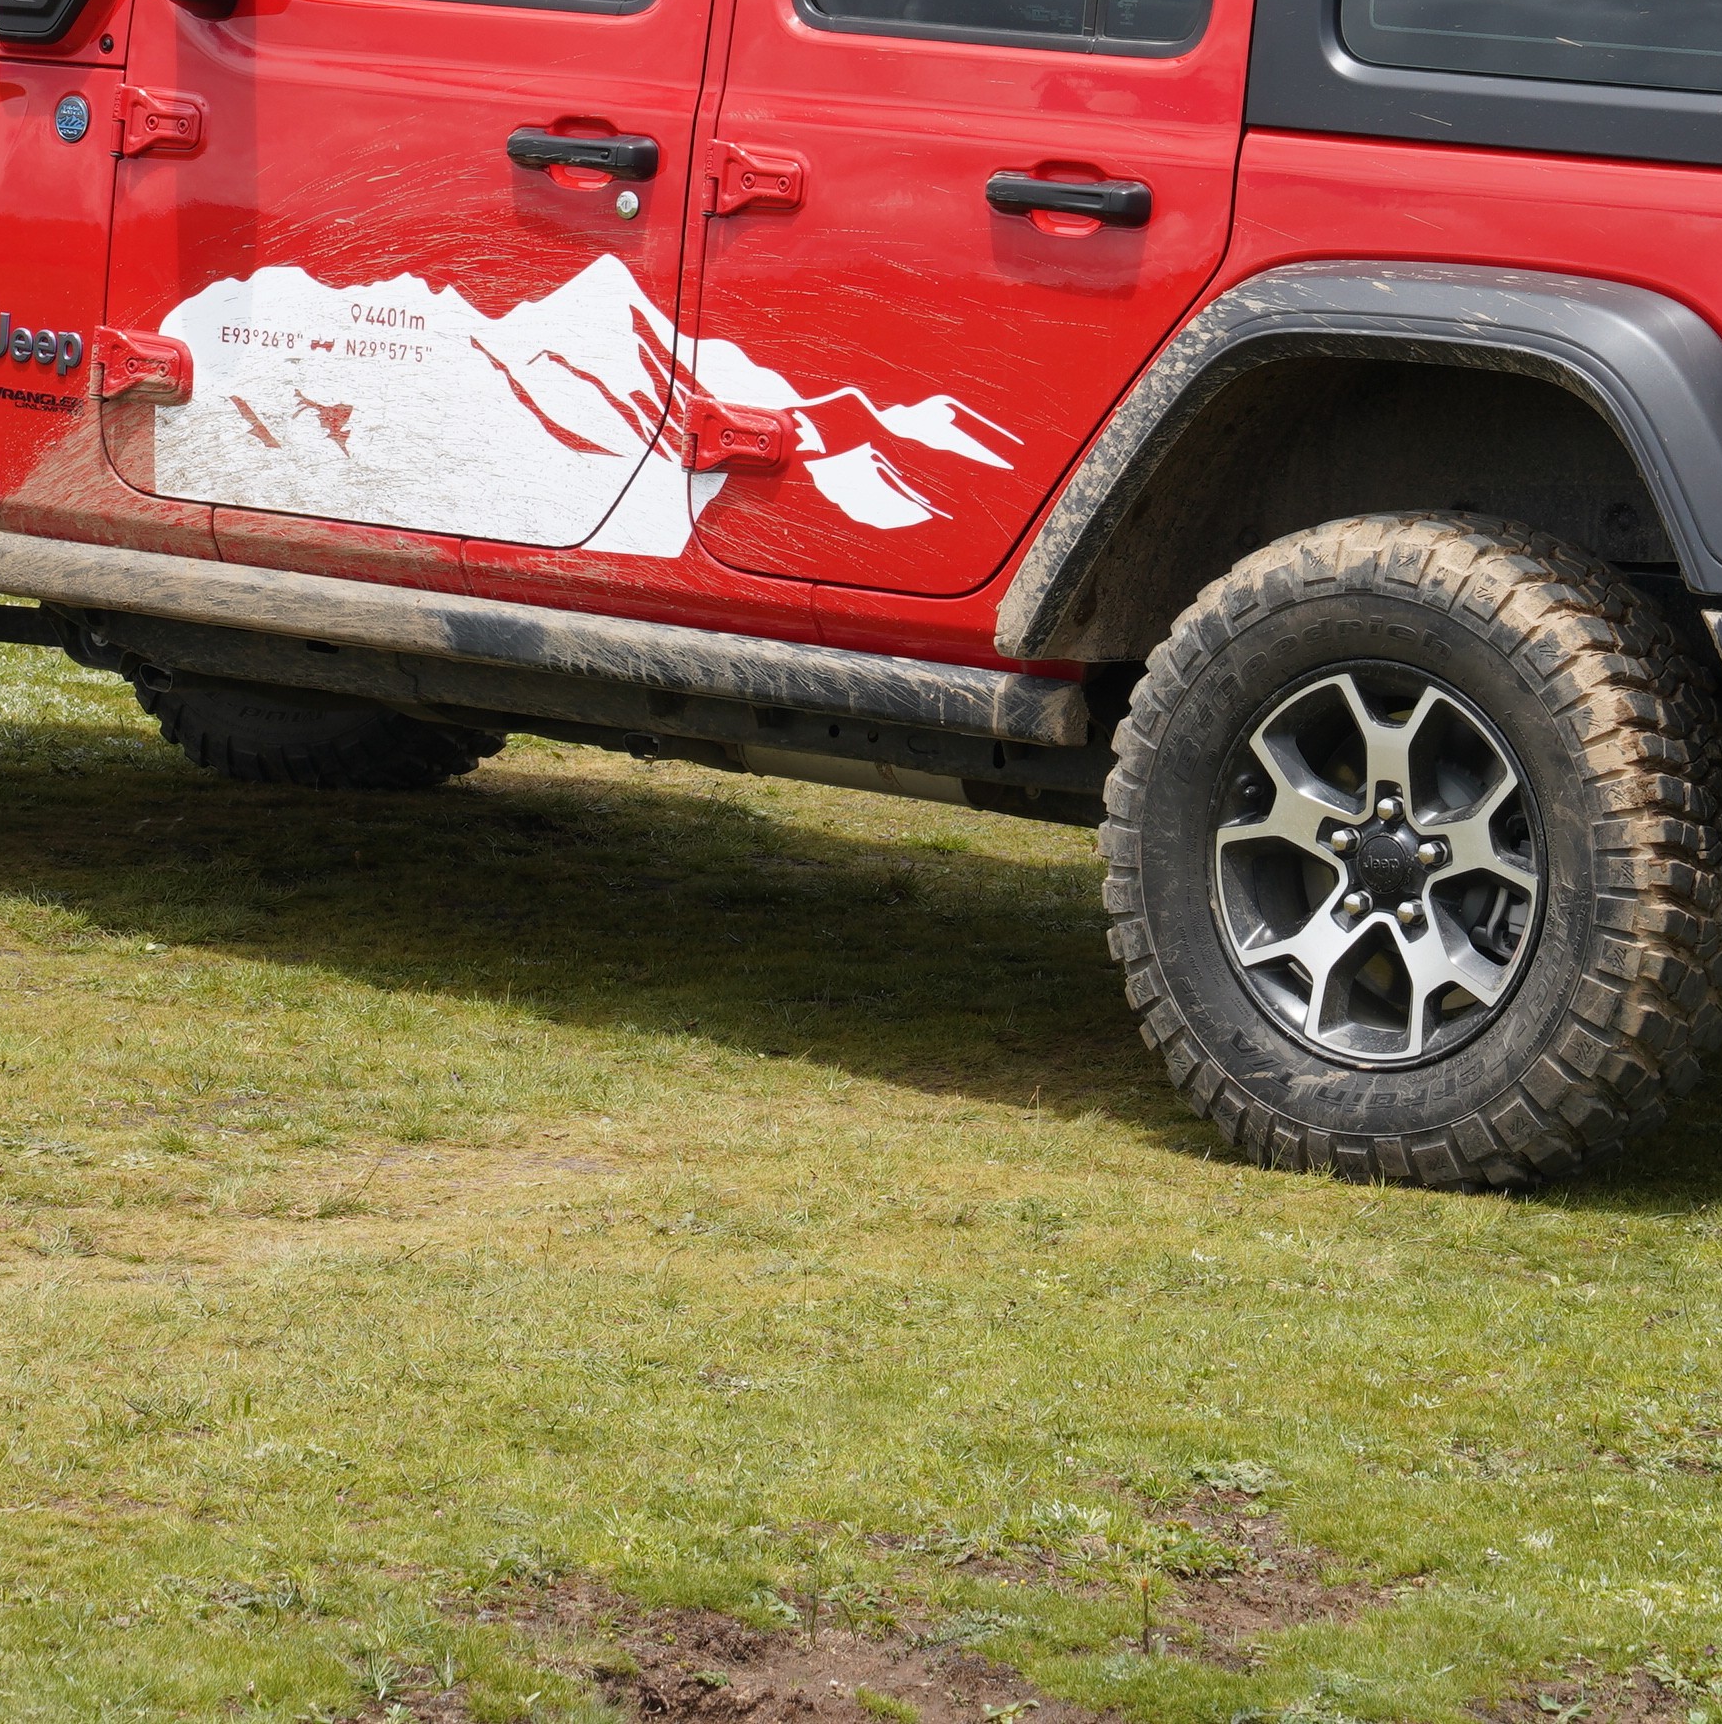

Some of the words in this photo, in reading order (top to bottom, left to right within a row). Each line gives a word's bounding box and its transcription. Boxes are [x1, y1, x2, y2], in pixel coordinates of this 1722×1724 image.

[366, 306, 425, 331] 4401m
[15, 401, 83, 417] UNLIMIT
[1173, 611, 1456, 784] BFGoodrich
